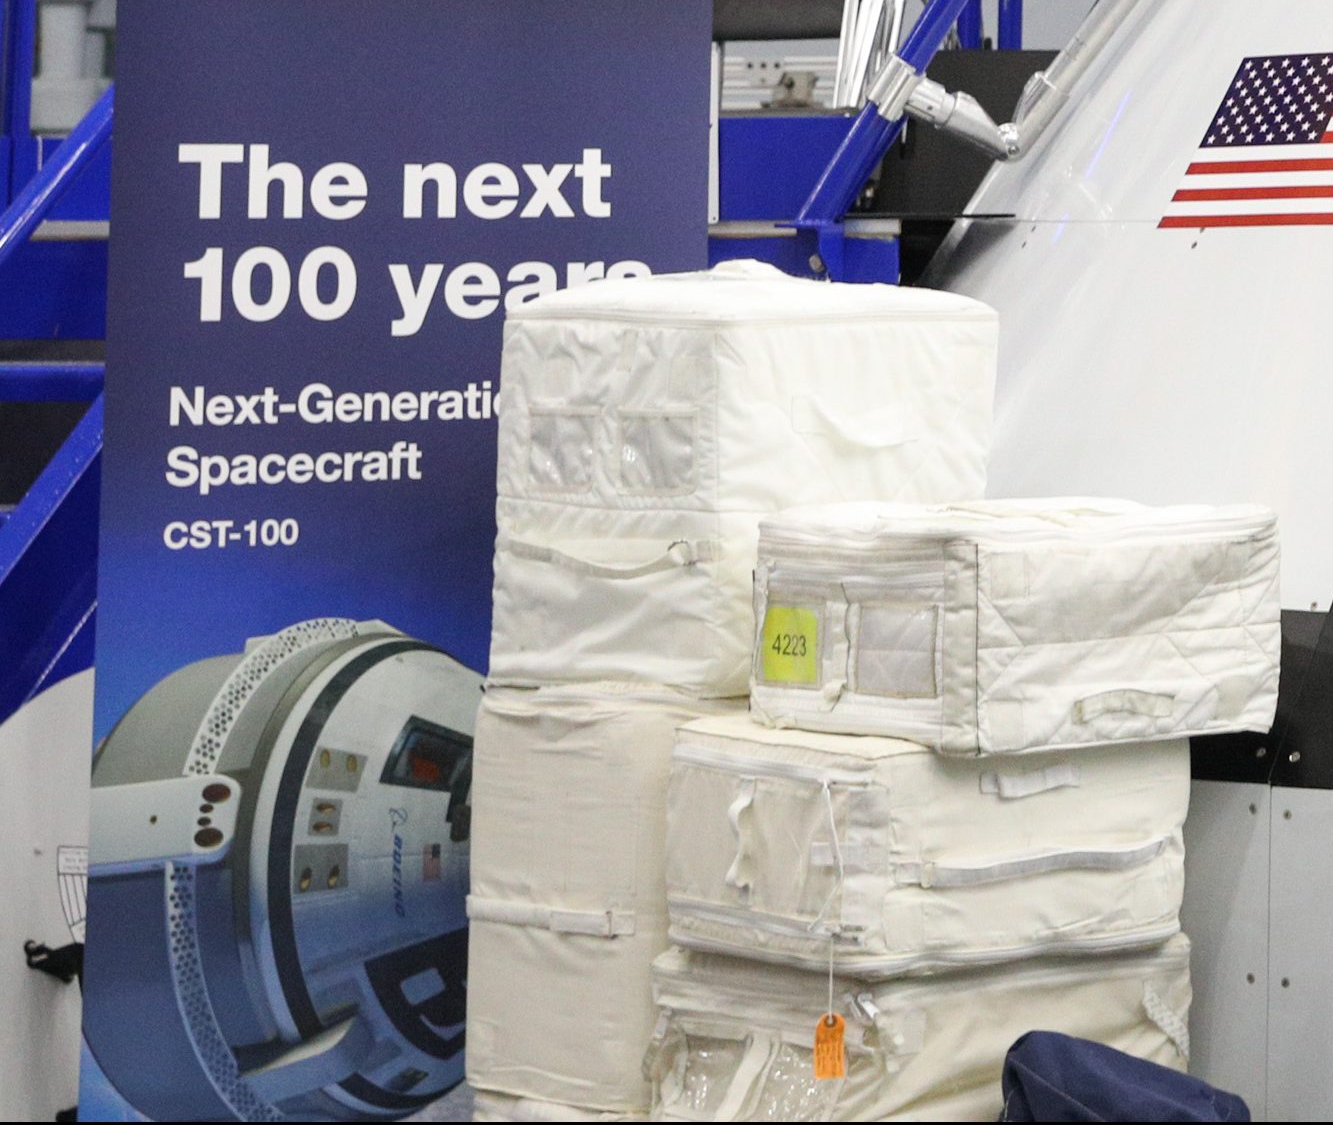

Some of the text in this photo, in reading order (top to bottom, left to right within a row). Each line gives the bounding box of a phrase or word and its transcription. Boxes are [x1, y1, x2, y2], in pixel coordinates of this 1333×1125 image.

[178, 144, 612, 220] The next
[184, 246, 358, 322] 100
[169, 381, 500, 426] Next-Generati
[165, 441, 422, 495] Spacecraft
[163, 518, 300, 550] CST-100
[771, 633, 808, 657] 4223
